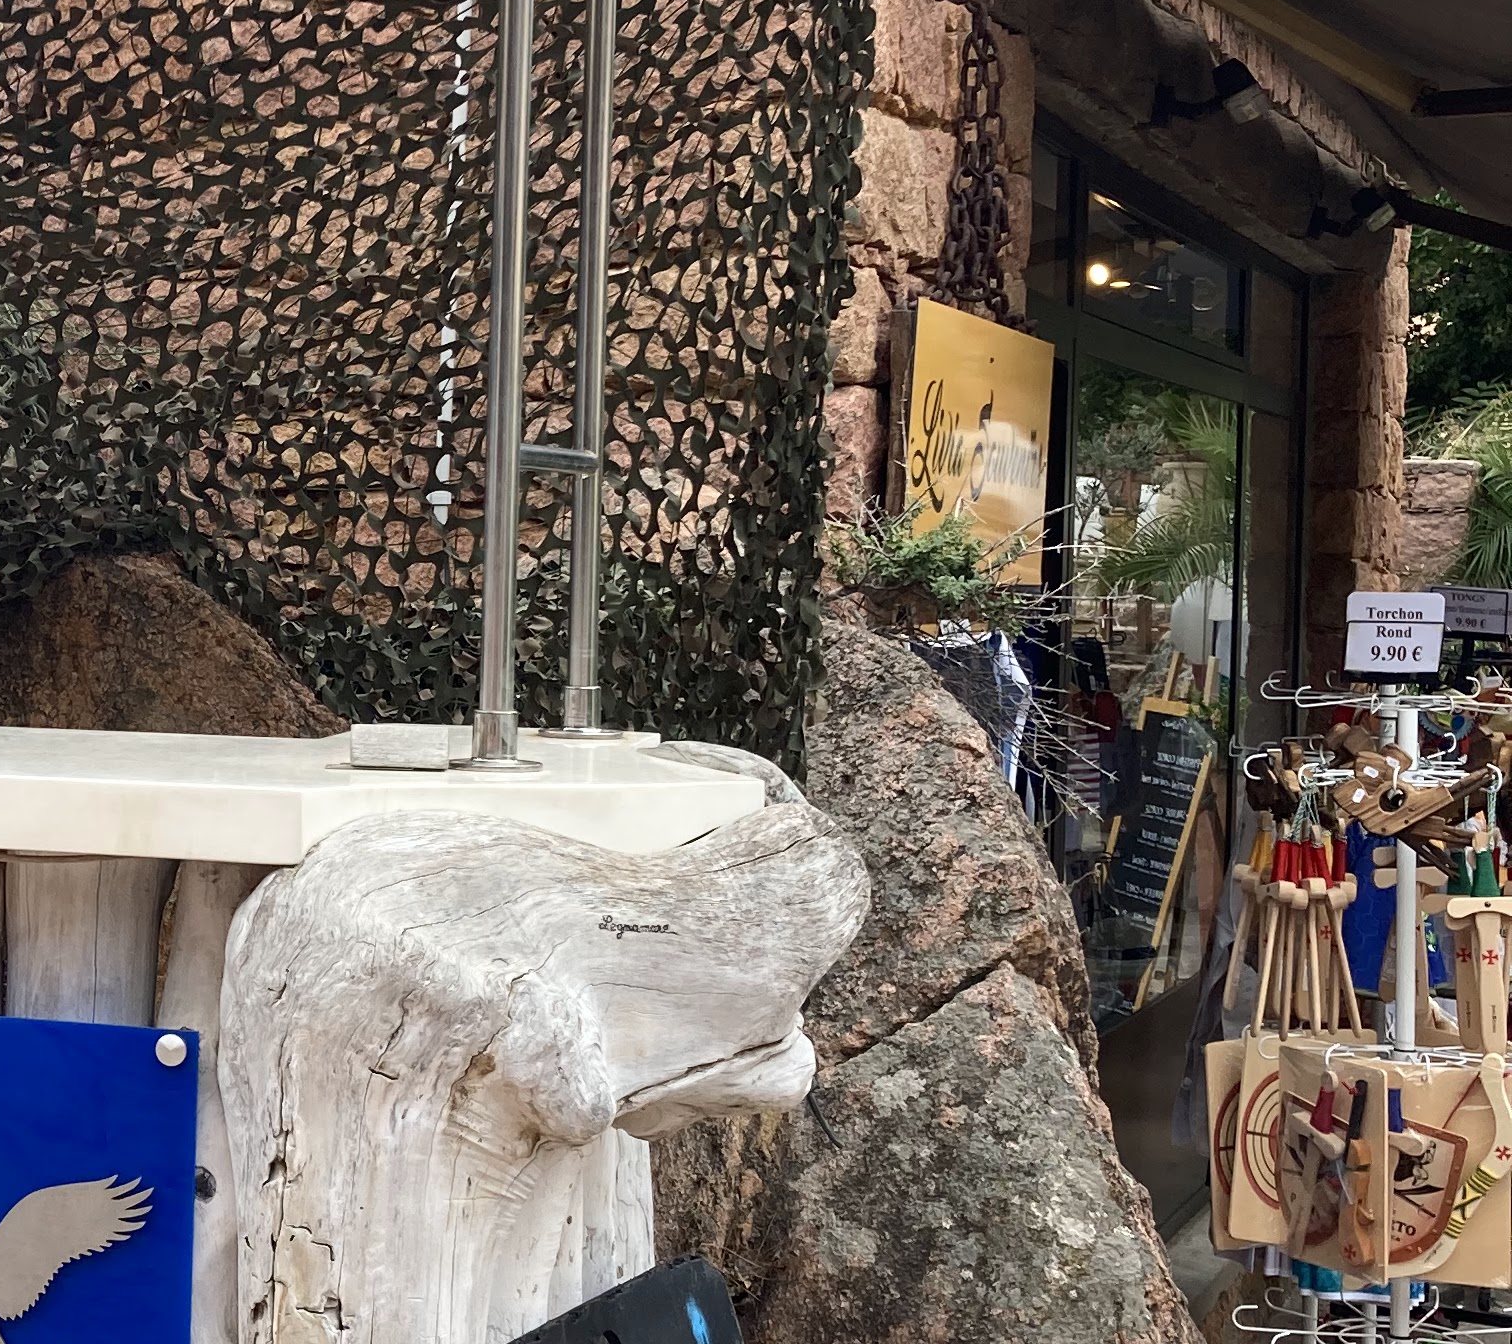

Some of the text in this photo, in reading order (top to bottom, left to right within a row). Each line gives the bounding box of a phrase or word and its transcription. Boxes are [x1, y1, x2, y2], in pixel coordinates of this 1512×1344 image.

[1451, 592, 1486, 603] TONGS
[1366, 607, 1423, 620] Torchon
[1376, 625, 1412, 638] Rond
[1370, 645, 1423, 662] 9.90 €
